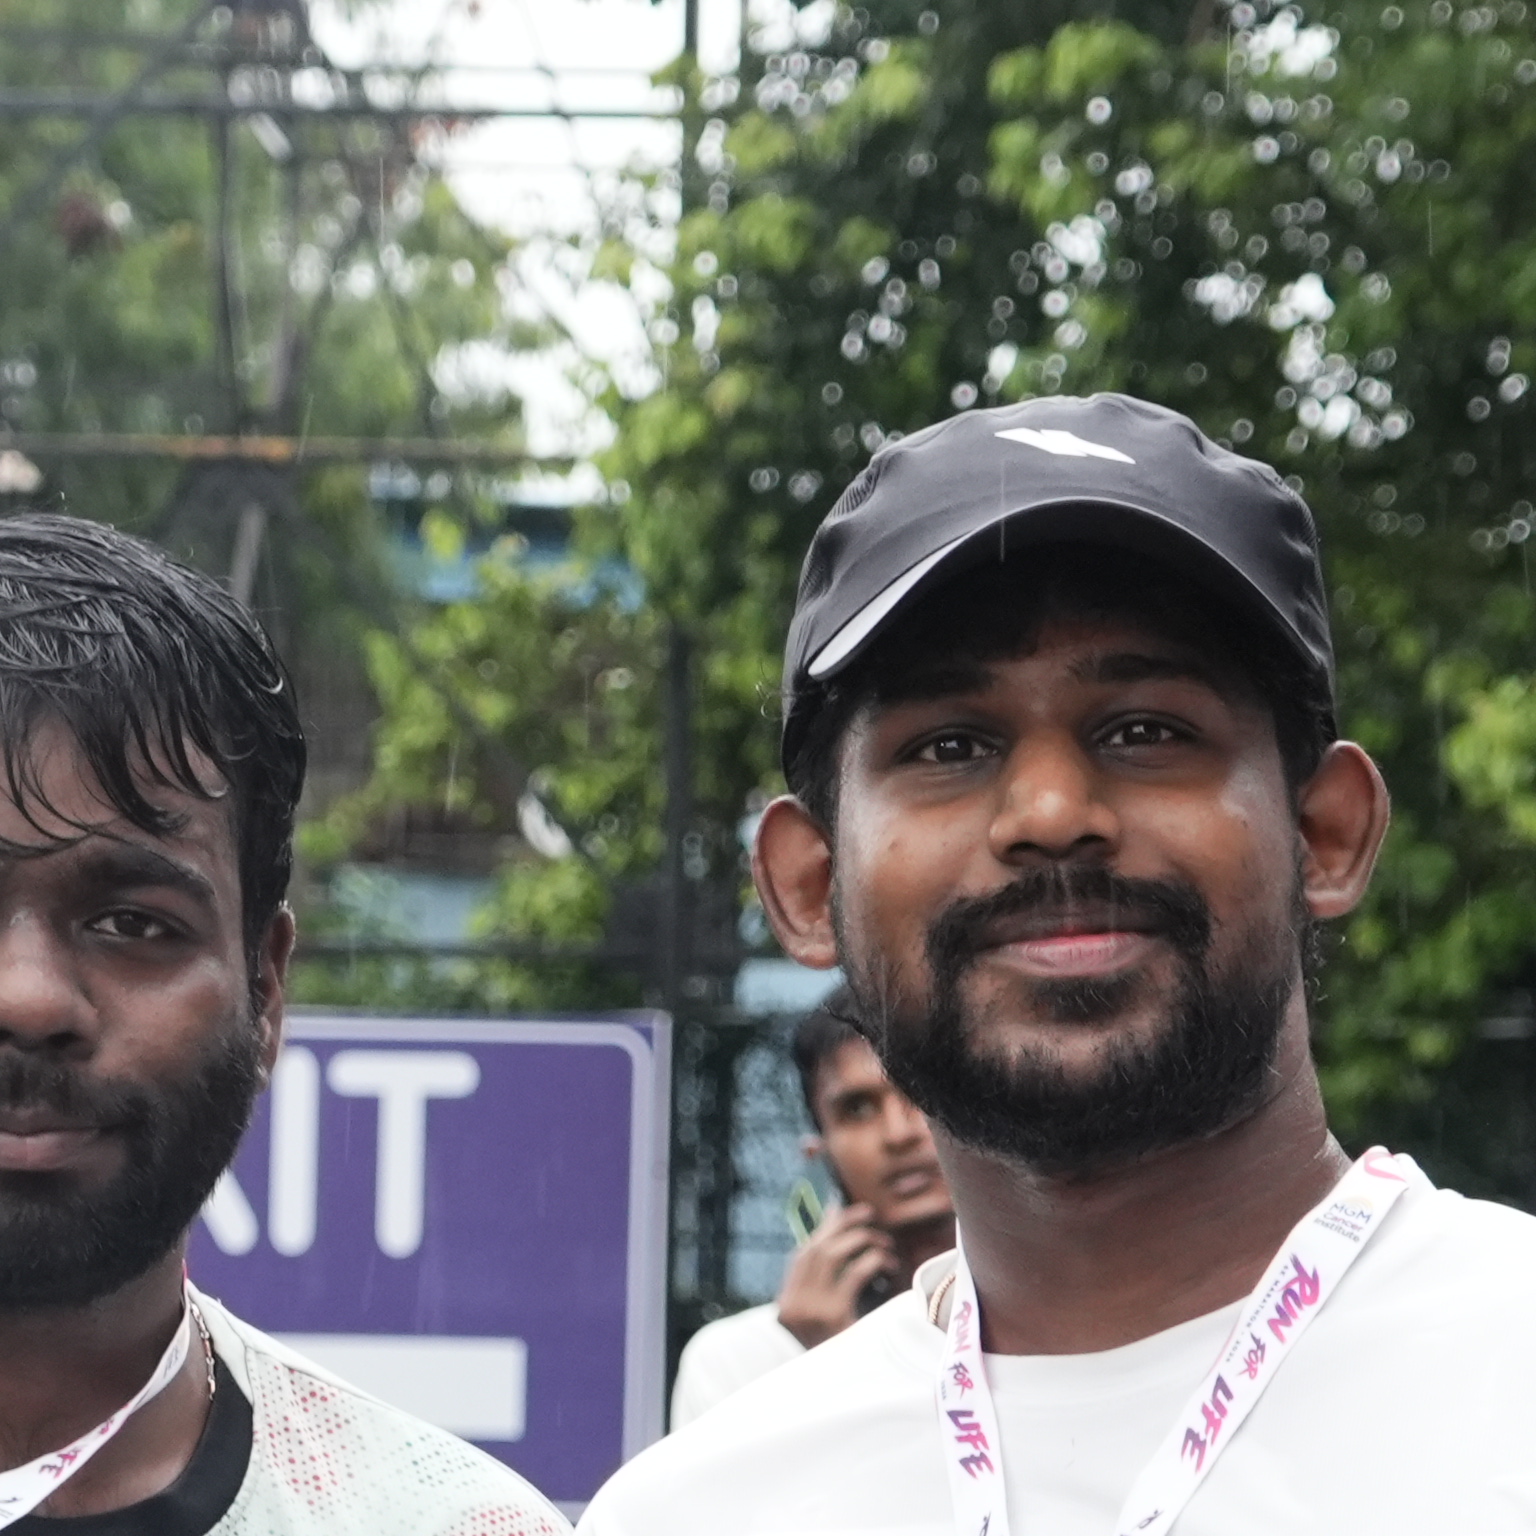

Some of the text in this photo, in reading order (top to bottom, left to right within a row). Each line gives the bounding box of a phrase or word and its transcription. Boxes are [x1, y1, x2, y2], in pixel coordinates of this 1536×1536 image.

[200, 1046, 481, 1259] IT
[1323, 1212, 1364, 1232] Cancer
[1330, 1202, 1373, 1224] MGM
[946, 1301, 995, 1480] RUN FOR LIFE
[1180, 1252, 1320, 1475] RUN FOR LIFE
